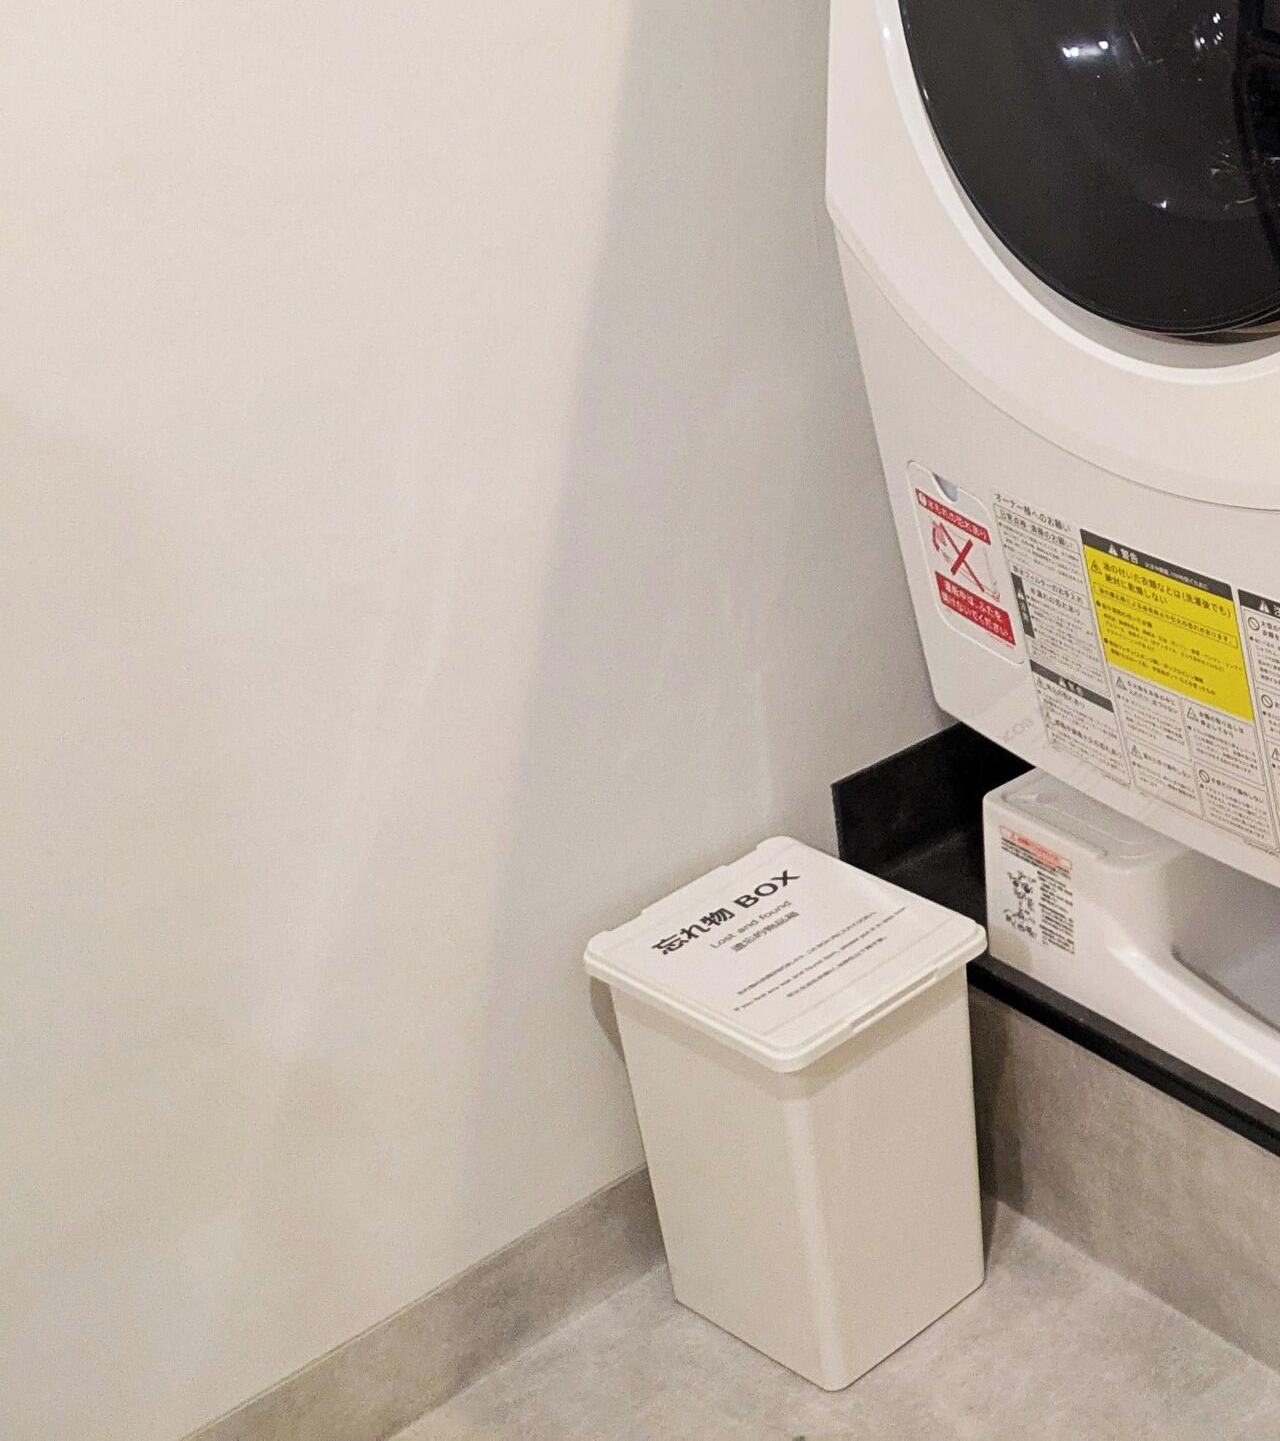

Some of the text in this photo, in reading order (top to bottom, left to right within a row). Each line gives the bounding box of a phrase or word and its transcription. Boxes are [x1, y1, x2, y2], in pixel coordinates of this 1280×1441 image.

[652, 870, 800, 956] 忘れ物 BOX
[710, 900, 792, 949] Lost and found
